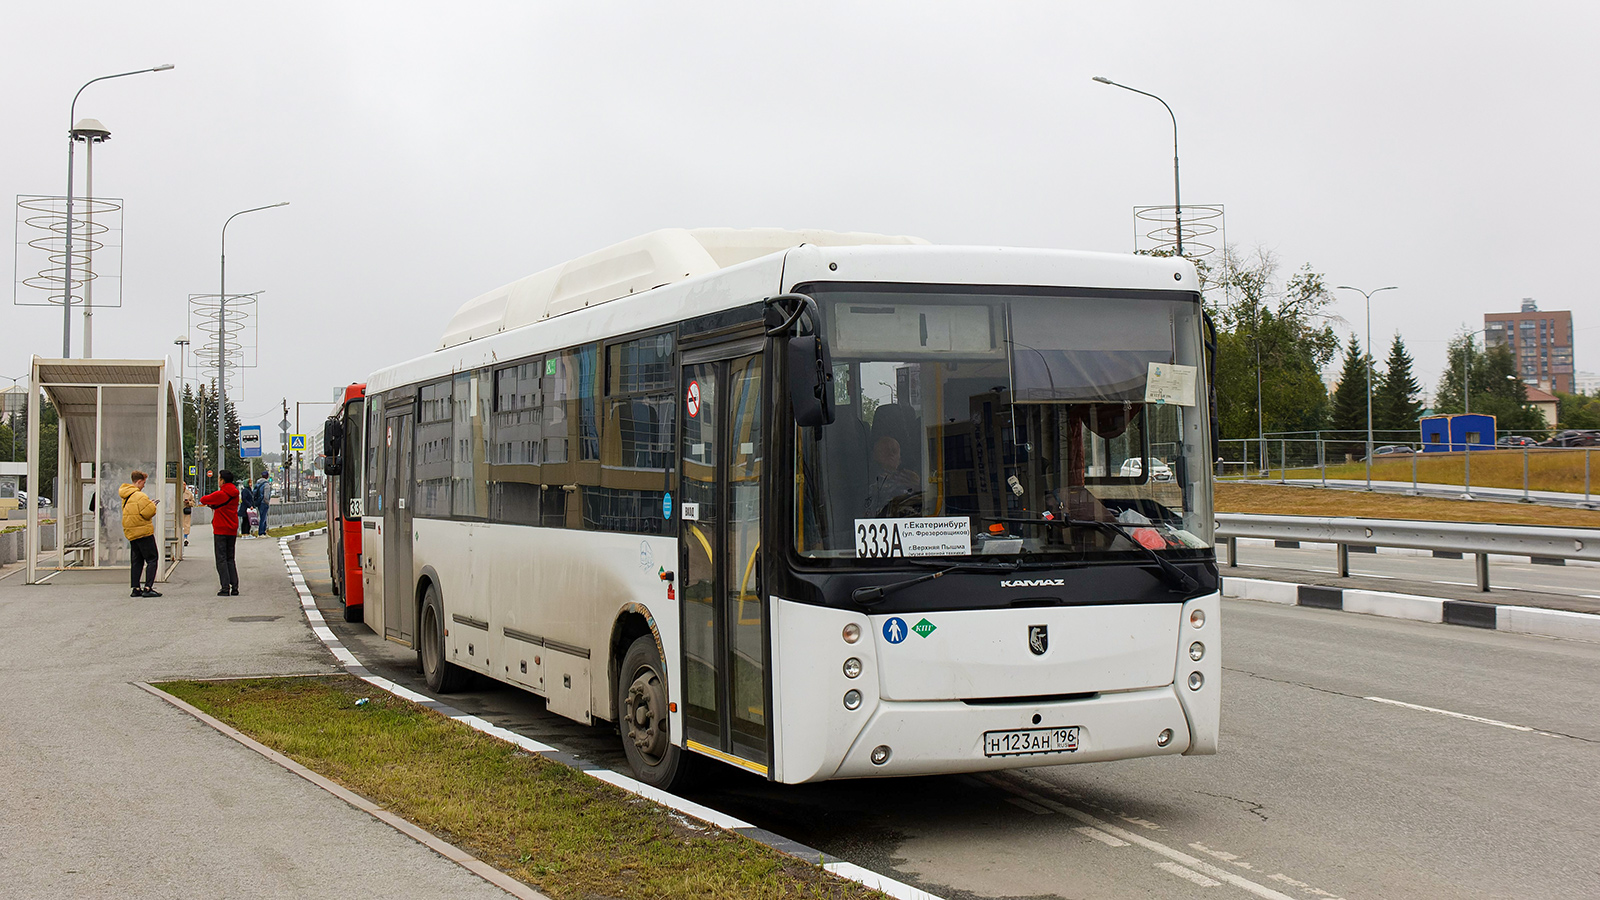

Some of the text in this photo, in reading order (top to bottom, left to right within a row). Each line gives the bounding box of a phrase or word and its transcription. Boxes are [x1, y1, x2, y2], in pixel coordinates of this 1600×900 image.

[350, 500, 362, 515] 33
[904, 521, 967, 529] г.Екатеринбург
[915, 529, 970, 537] Фрезеровщиков)
[857, 523, 905, 558] 333А
[1001, 579, 1065, 588] KAMAZ
[915, 624, 934, 632] КПГ
[1053, 729, 1075, 743] 196
